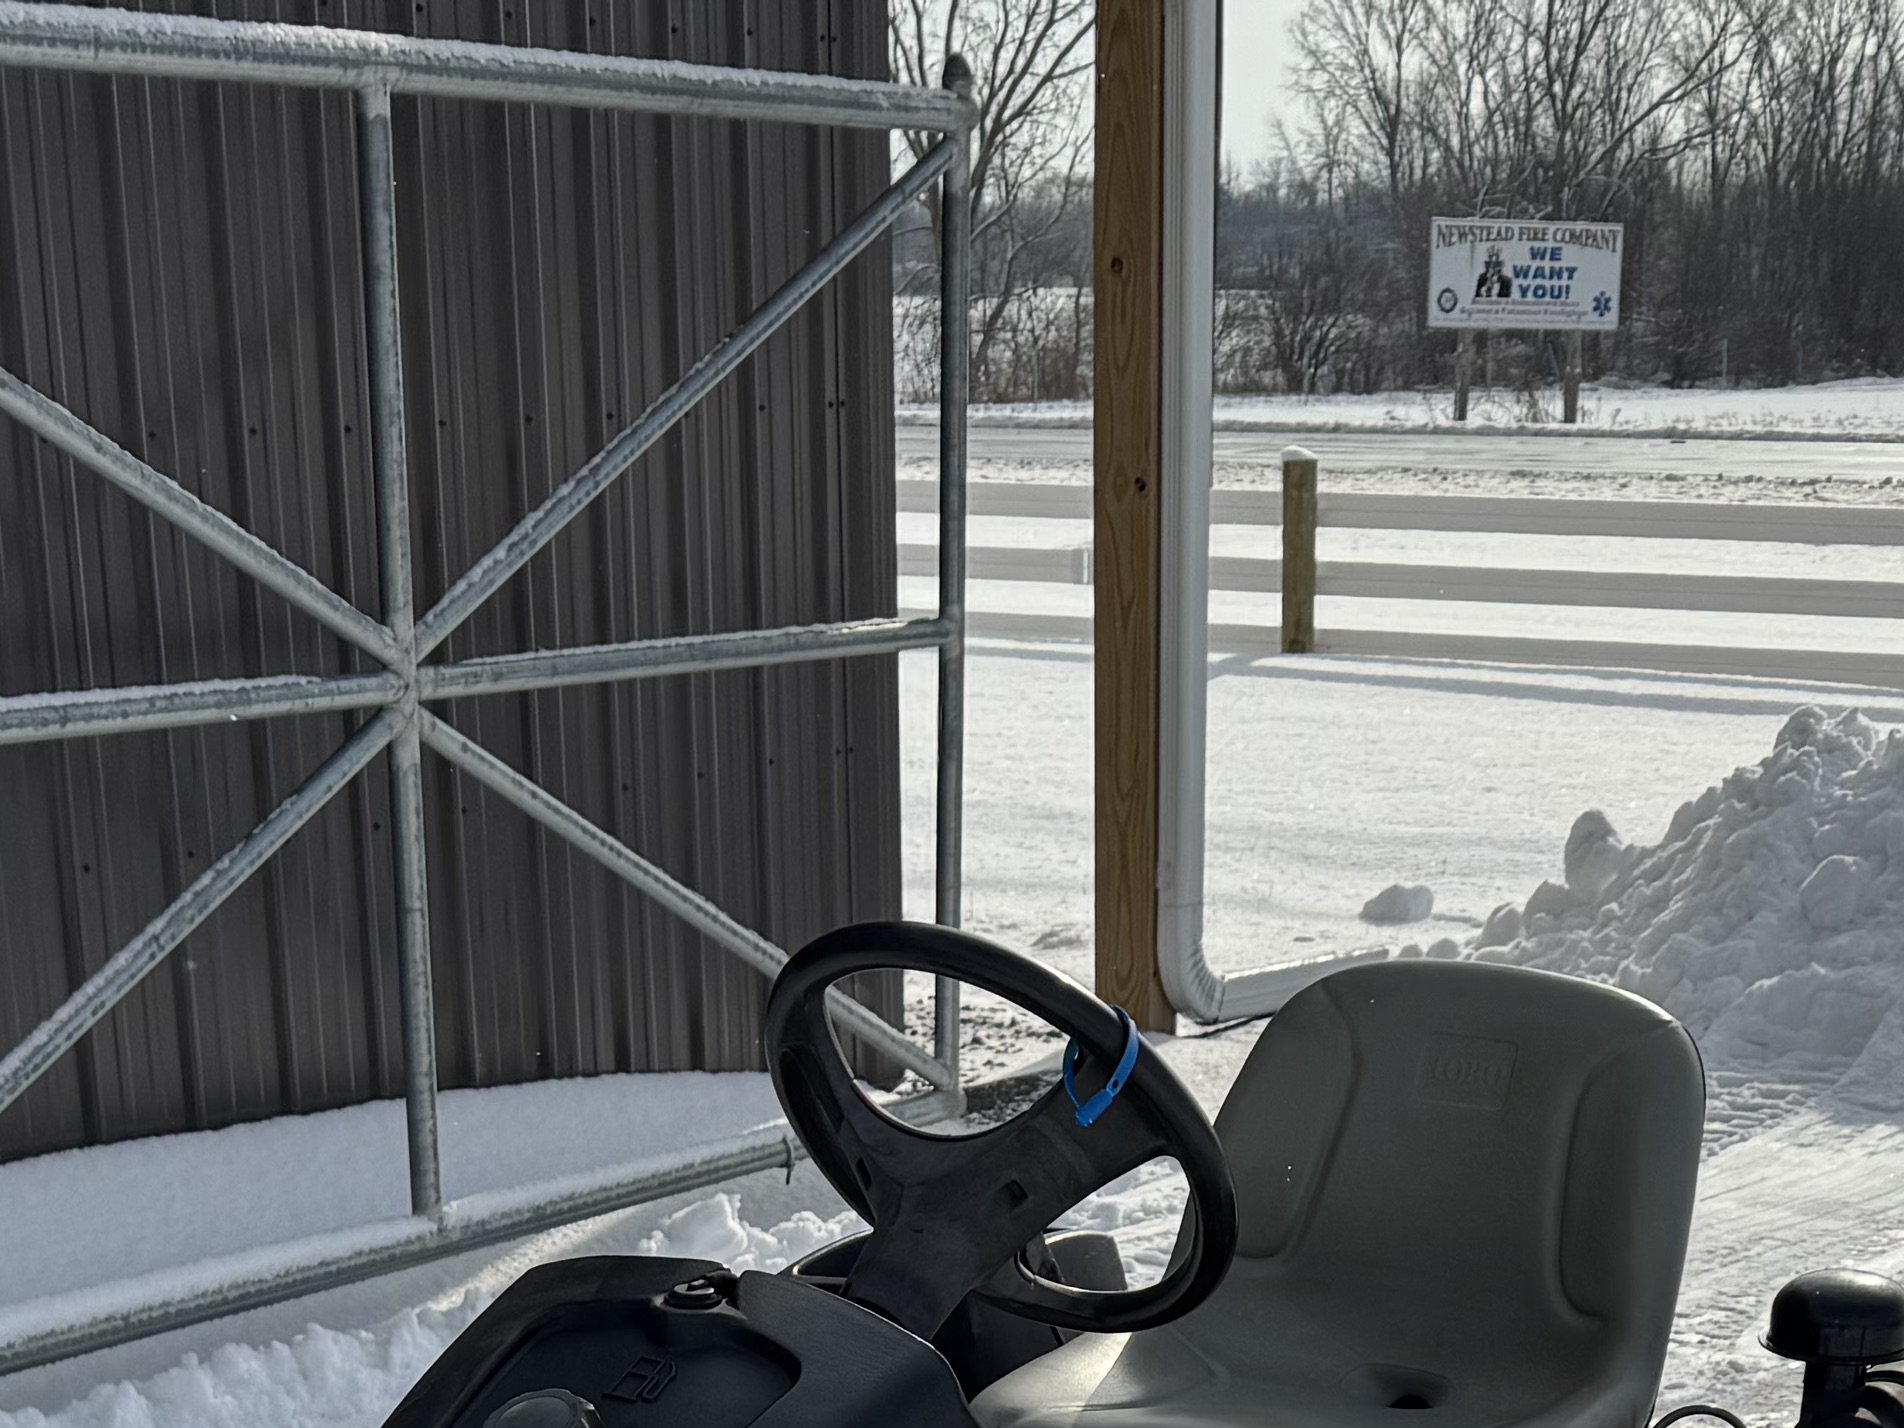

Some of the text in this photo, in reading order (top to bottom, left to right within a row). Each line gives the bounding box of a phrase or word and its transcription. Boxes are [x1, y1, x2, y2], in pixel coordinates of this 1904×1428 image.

[1436, 224, 1620, 253] NEWSTEAD FIRE COMPANY
[1529, 246, 1562, 261] WE
[1513, 265, 1578, 280] WANT
[1518, 284, 1570, 299] YOU!
